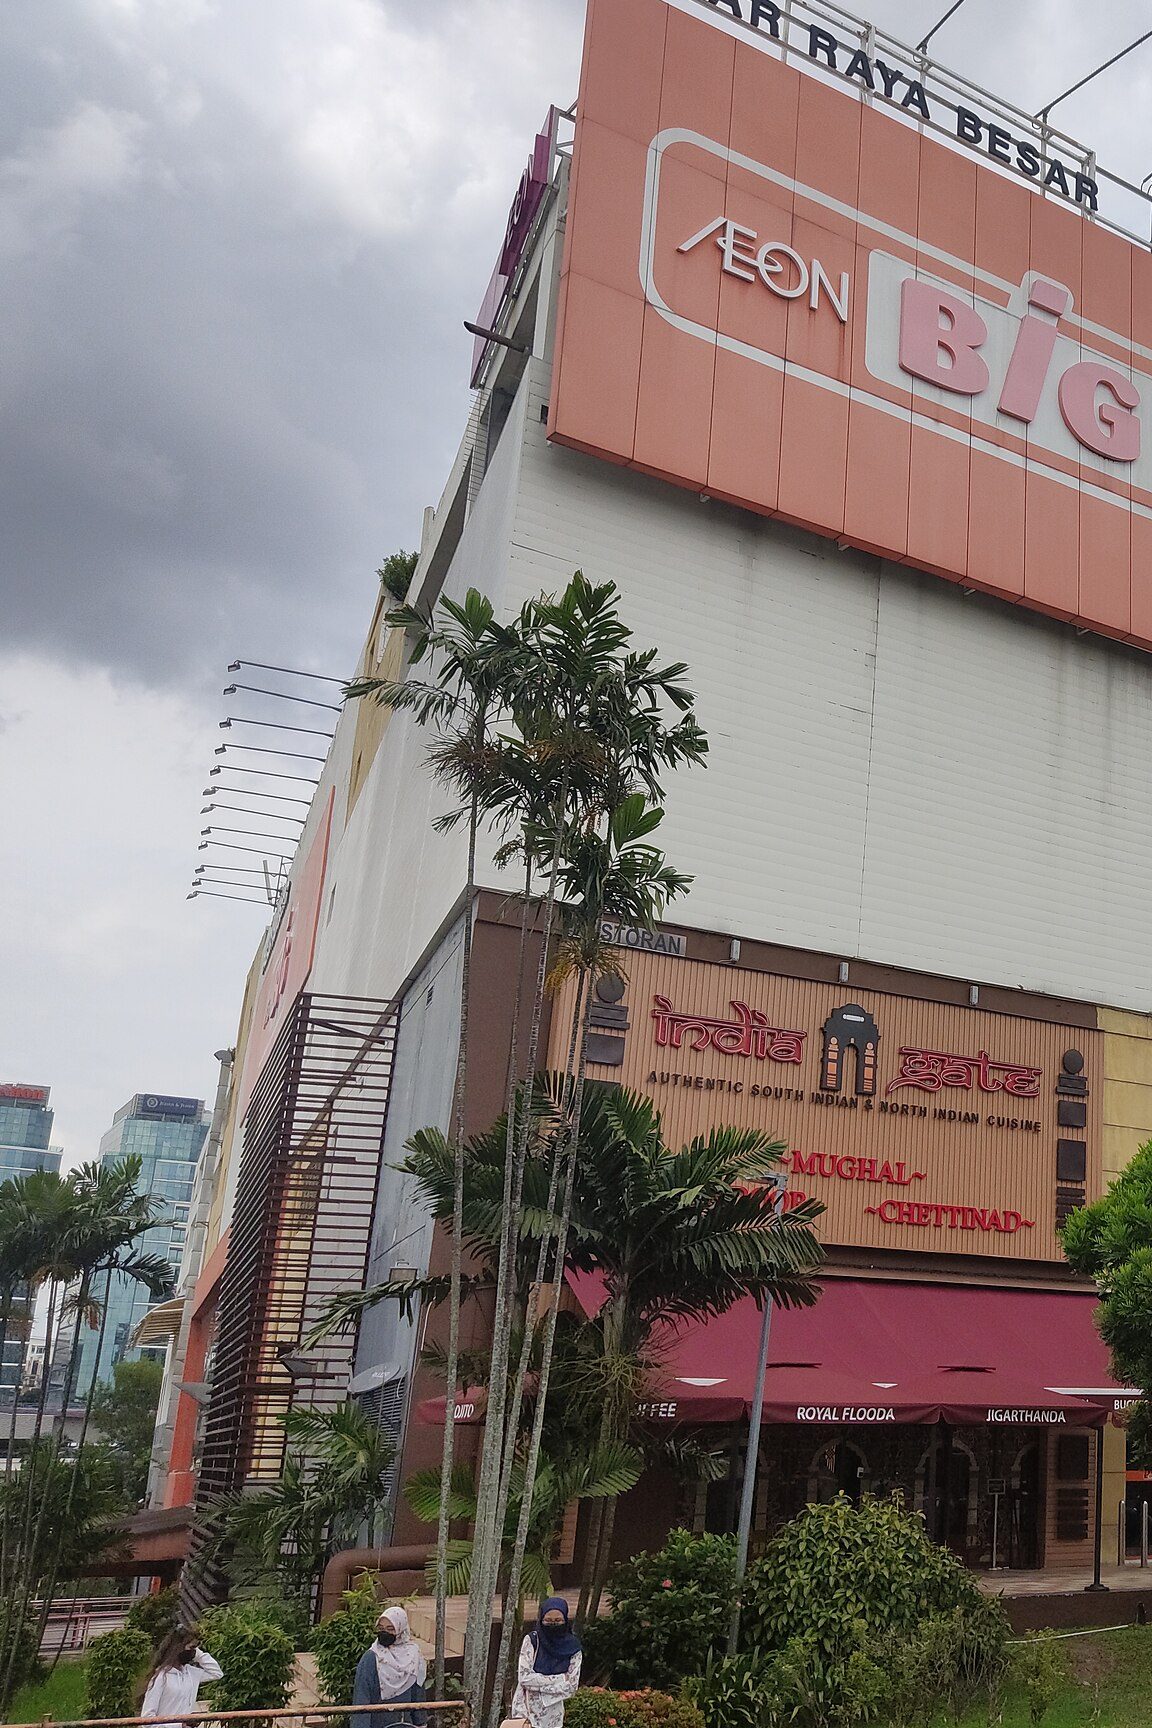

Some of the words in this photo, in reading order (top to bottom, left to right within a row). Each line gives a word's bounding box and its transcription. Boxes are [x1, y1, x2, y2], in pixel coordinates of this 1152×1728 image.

[809, 24, 930, 119] RAYA
[957, 105, 1099, 211] BESAR
[600, 923, 680, 954] STORAN
[651, 994, 807, 1064] india
[886, 1045, 1043, 1097] gate
[647, 1071, 743, 1094] AUTHENTIC
[751, 1084, 804, 1102] SOUTH
[810, 1092, 858, 1109] INDIAN
[863, 1098, 874, 1110] &
[879, 1101, 927, 1118] NORTH
[933, 1110, 979, 1124] INDIAN
[987, 1116, 1042, 1133] CUISINE
[454, 1403, 474, 1419] OJITO
[796, 1406, 840, 1420] ROYAL
[842, 1407, 896, 1421] FLOODA
[986, 1409, 1067, 1423] JIGARTHANDA
